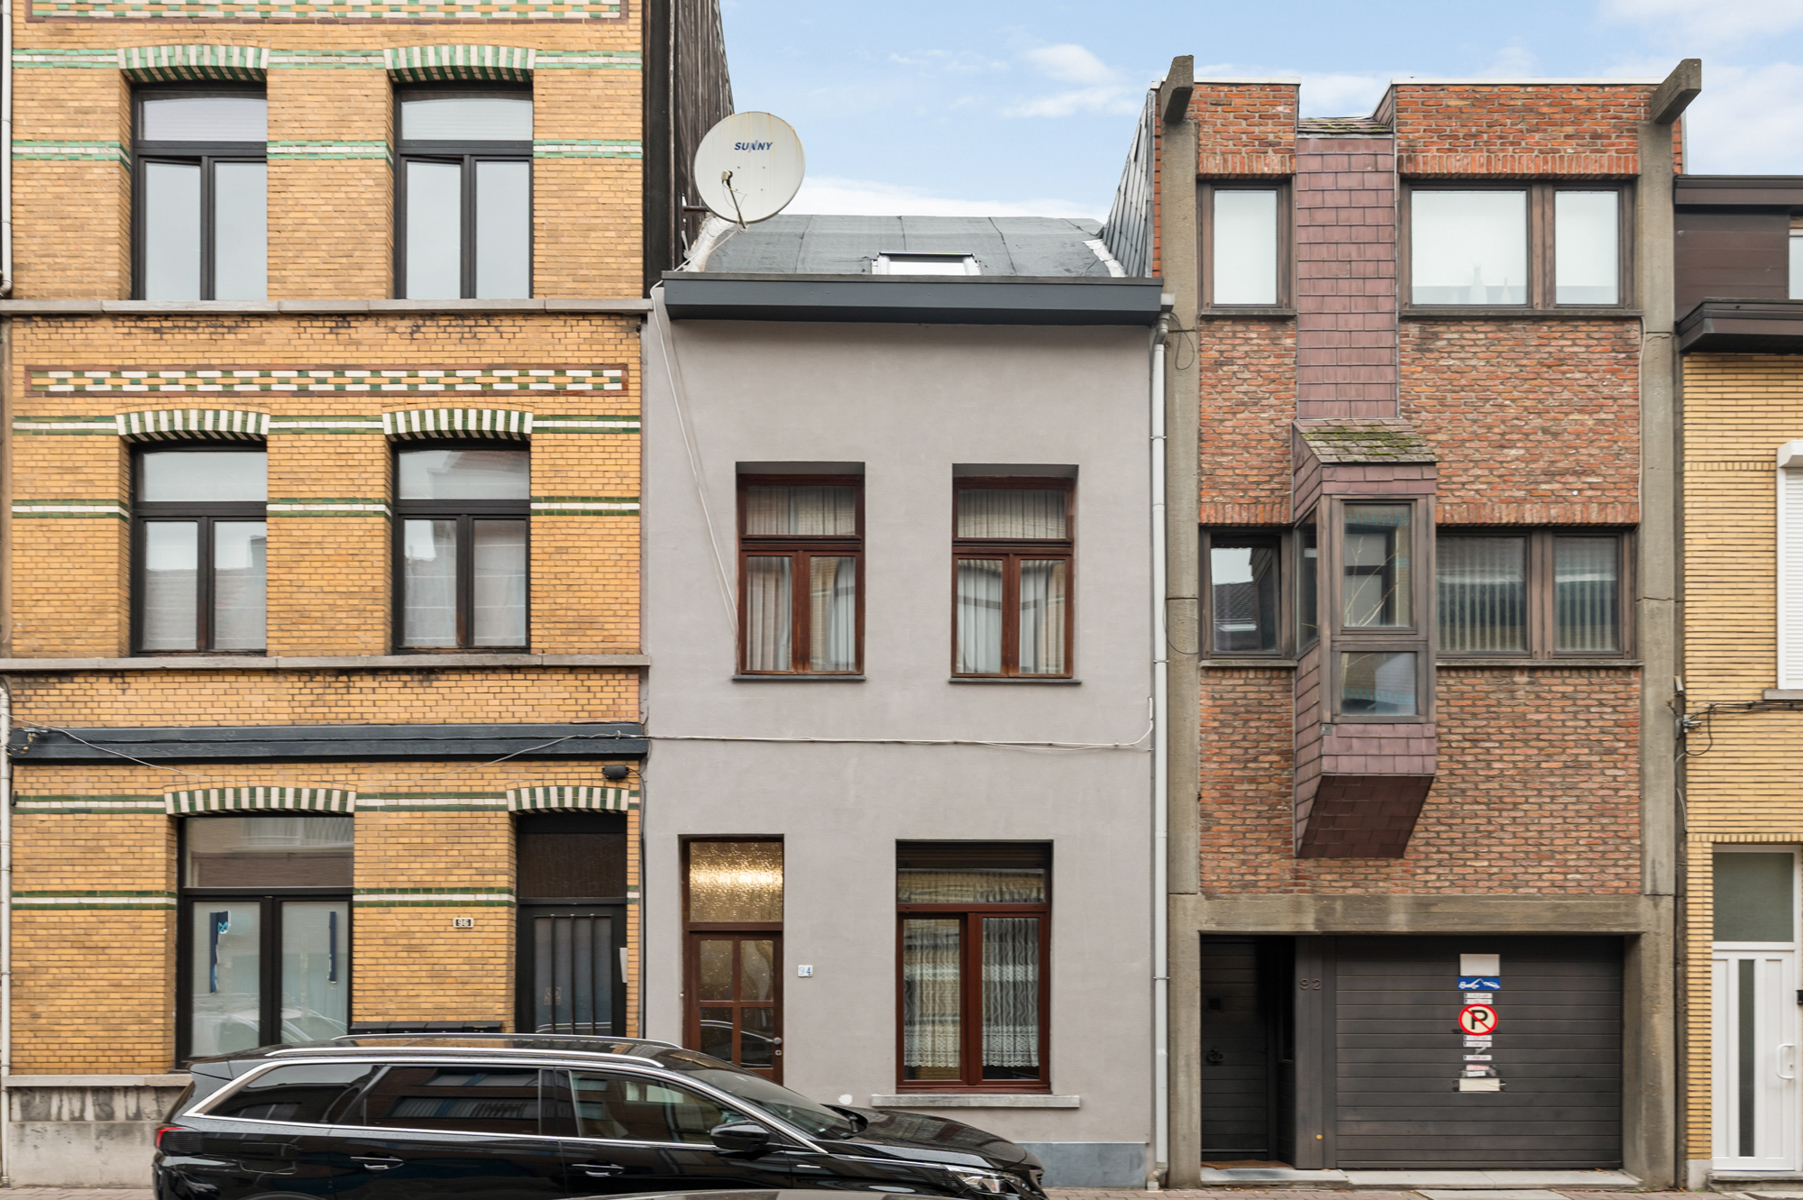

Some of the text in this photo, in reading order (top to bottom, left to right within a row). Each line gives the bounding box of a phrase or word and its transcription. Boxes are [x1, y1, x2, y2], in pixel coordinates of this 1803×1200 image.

[734, 140, 773, 152] SUNNY
[798, 966, 812, 976] 94
[1300, 979, 1321, 990] 92
[1471, 1009, 1488, 1030] P
